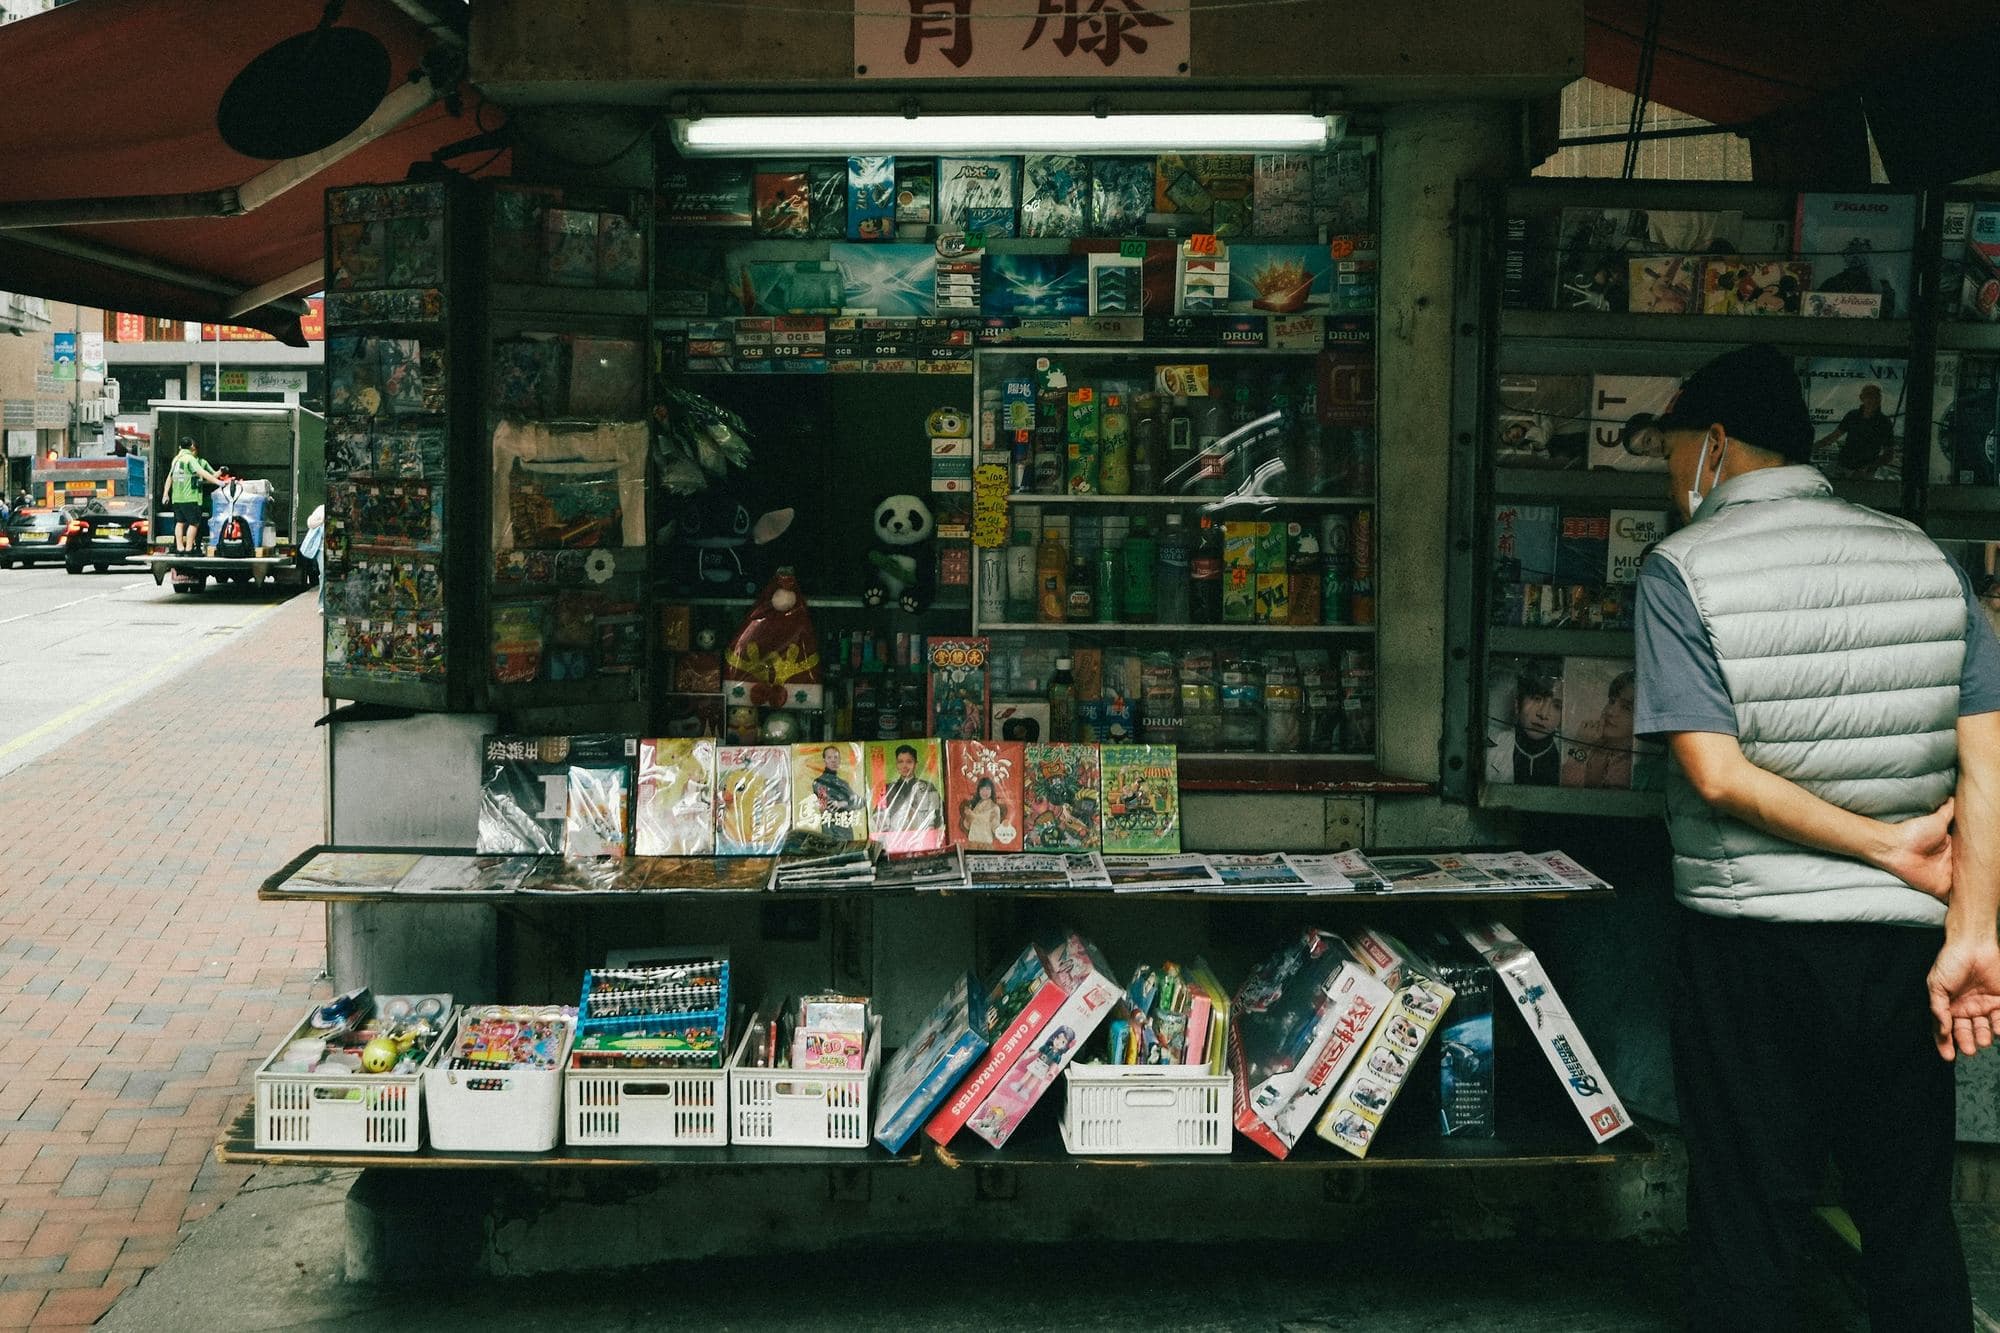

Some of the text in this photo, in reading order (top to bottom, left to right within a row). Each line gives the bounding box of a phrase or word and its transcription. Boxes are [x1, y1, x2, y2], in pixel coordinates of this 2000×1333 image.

[968, 233, 983, 246] 79
[1193, 235, 1215, 252] 118
[1122, 242, 1144, 256] 100
[1506, 249, 1524, 282] UXURY
[786, 333, 811, 342] OCB
[1222, 331, 1264, 342] DRUM
[1328, 330, 1370, 341] DRUM
[742, 348, 764, 356] OCB
[774, 346, 800, 356] OCB
[834, 348, 852, 356] OCB
[875, 346, 897, 355] OCB
[931, 348, 953, 357] OCB
[1143, 717, 1183, 727] DRUM
[1551, 1037, 1580, 1080] HEROES
[951, 1022, 1030, 1117] GAME CHARACTERS
